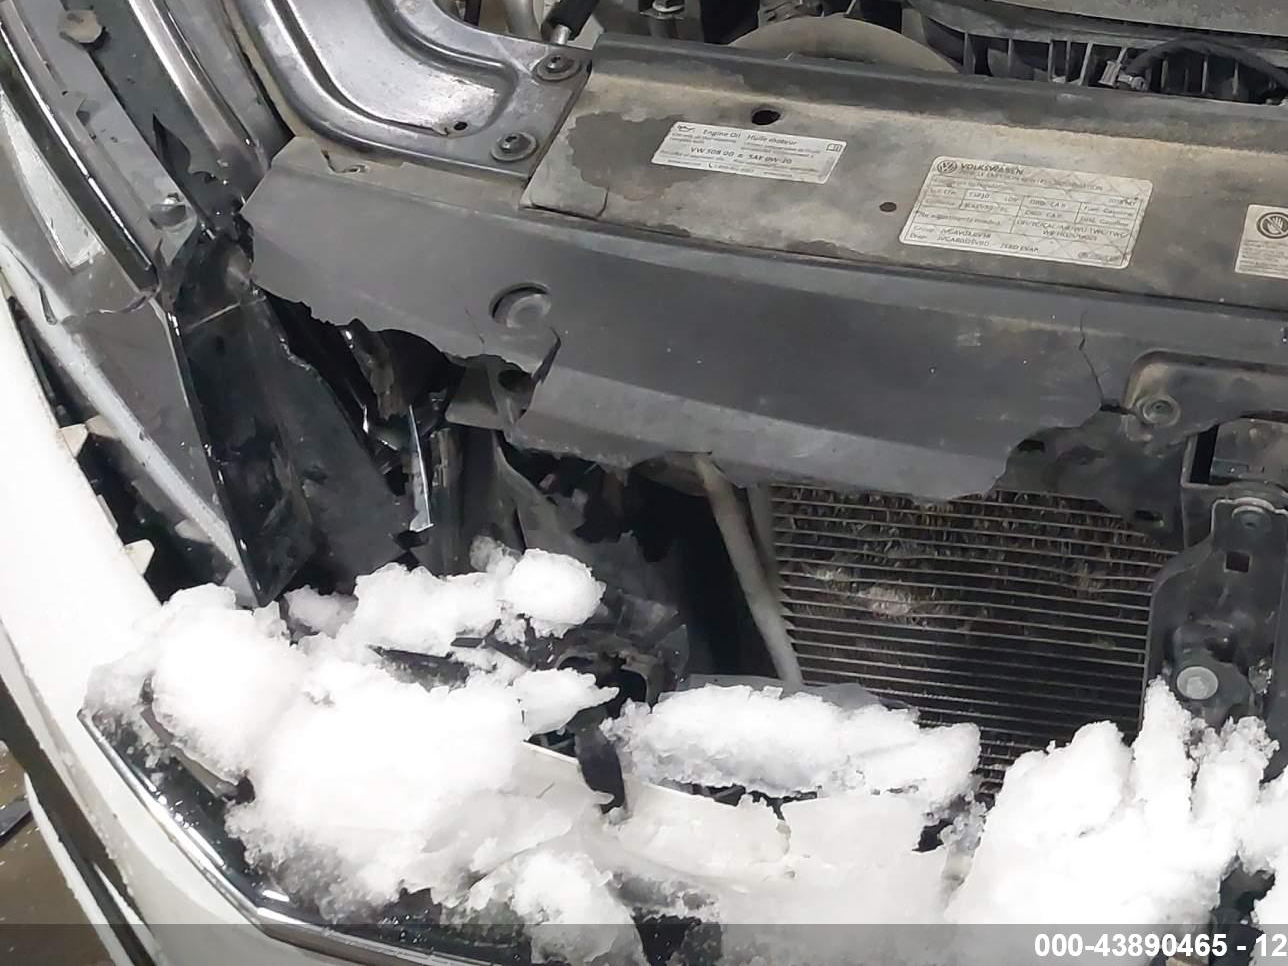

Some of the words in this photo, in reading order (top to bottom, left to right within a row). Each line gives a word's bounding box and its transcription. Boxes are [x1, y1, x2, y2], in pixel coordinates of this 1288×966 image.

[703, 129, 729, 138] Engine
[690, 146, 705, 154] VW
[960, 162, 1024, 176] VOLKSWAGEN
